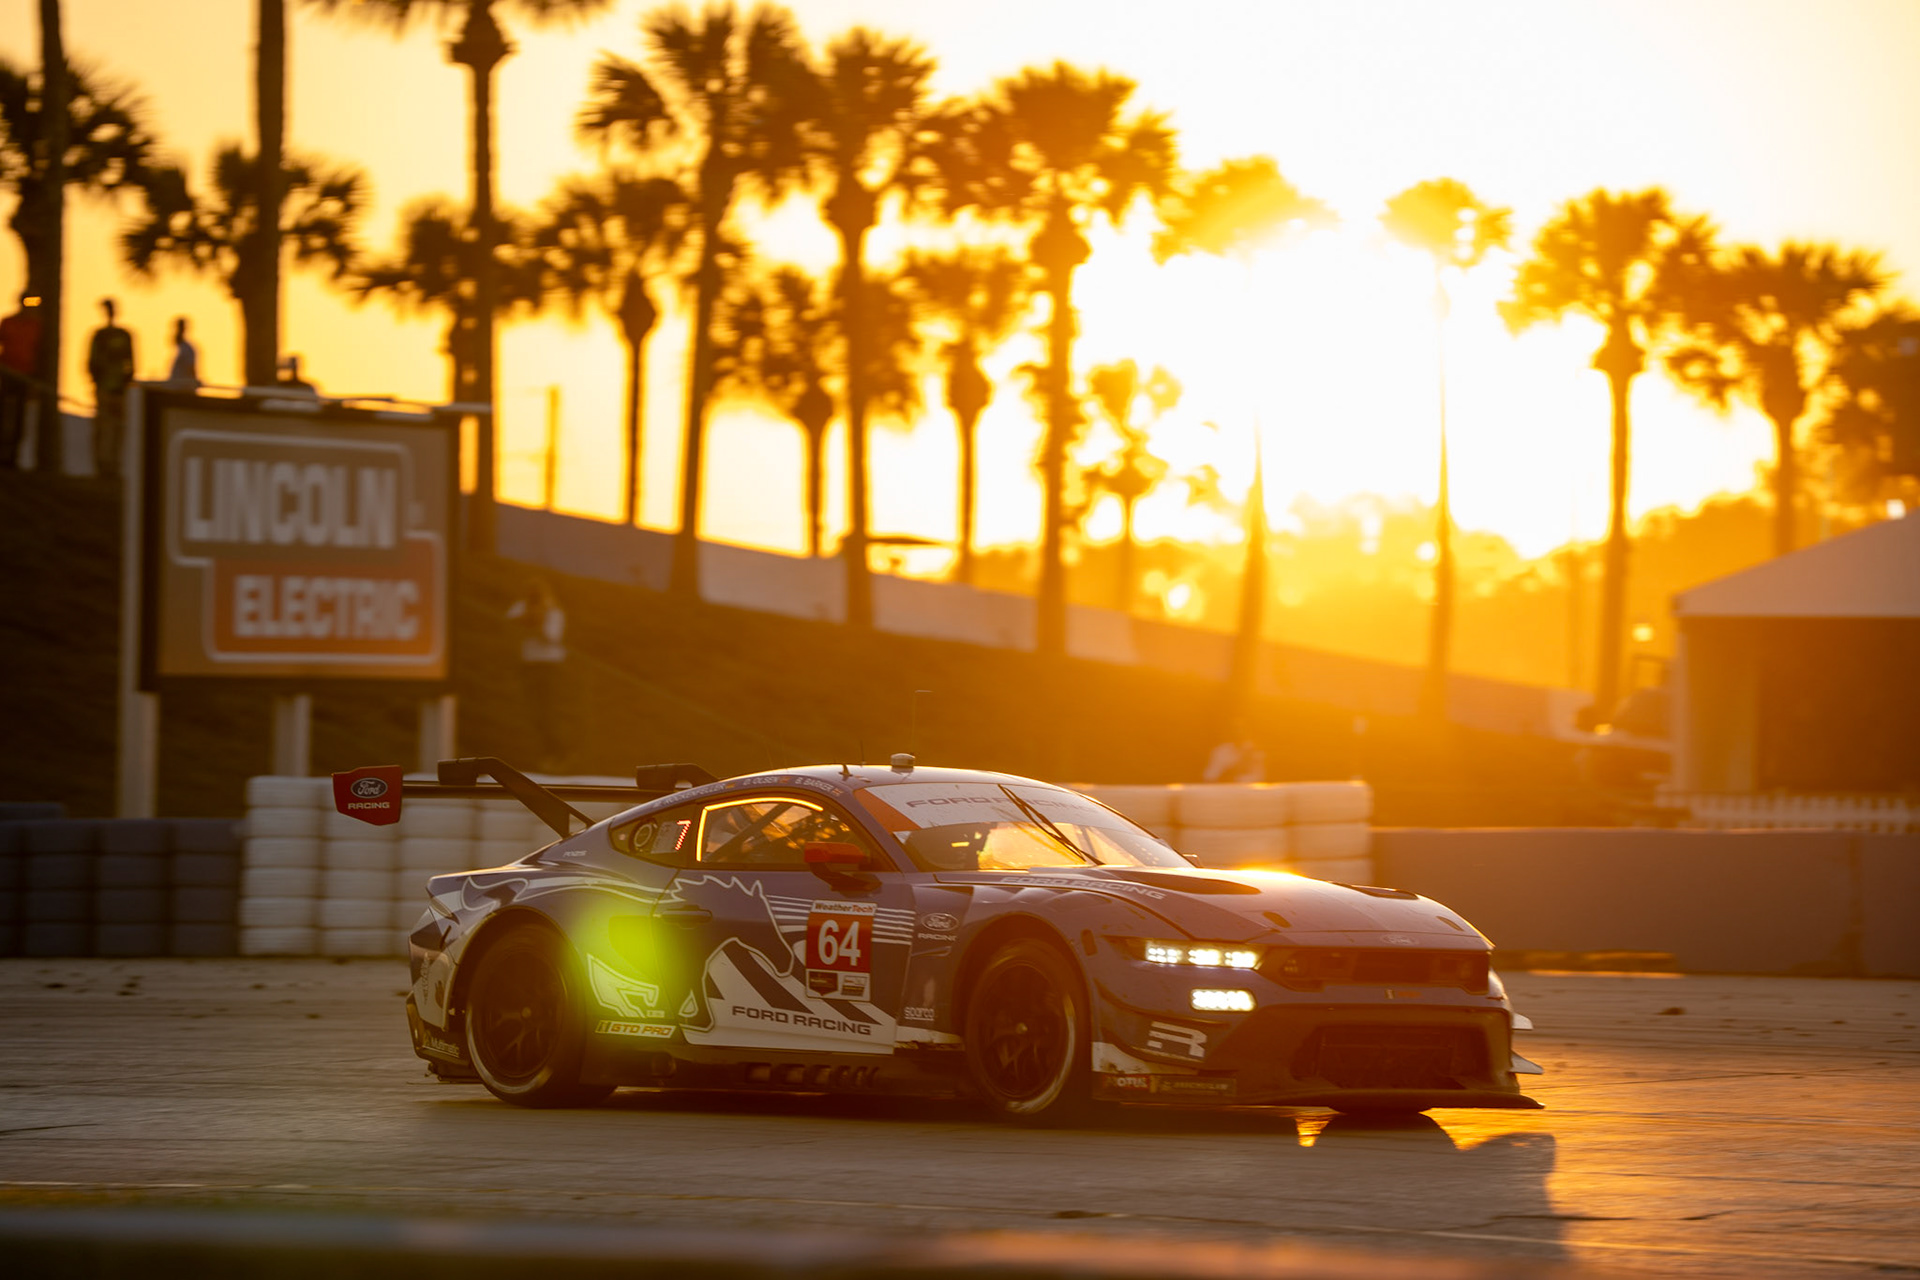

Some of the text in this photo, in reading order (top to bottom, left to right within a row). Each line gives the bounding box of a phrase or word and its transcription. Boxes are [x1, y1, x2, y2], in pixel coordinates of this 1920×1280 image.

[184, 456, 398, 549] LINCOLN
[232, 574, 421, 641] ELECTRIC
[357, 780, 381, 795] Ford
[347, 802, 391, 810] RACING
[906, 796, 991, 808] FORD
[1070, 880, 1168, 901] RACING
[818, 919, 861, 967] 64
[610, 1023, 672, 1036] GTD PRO
[732, 1005, 871, 1036] FORD RACING
